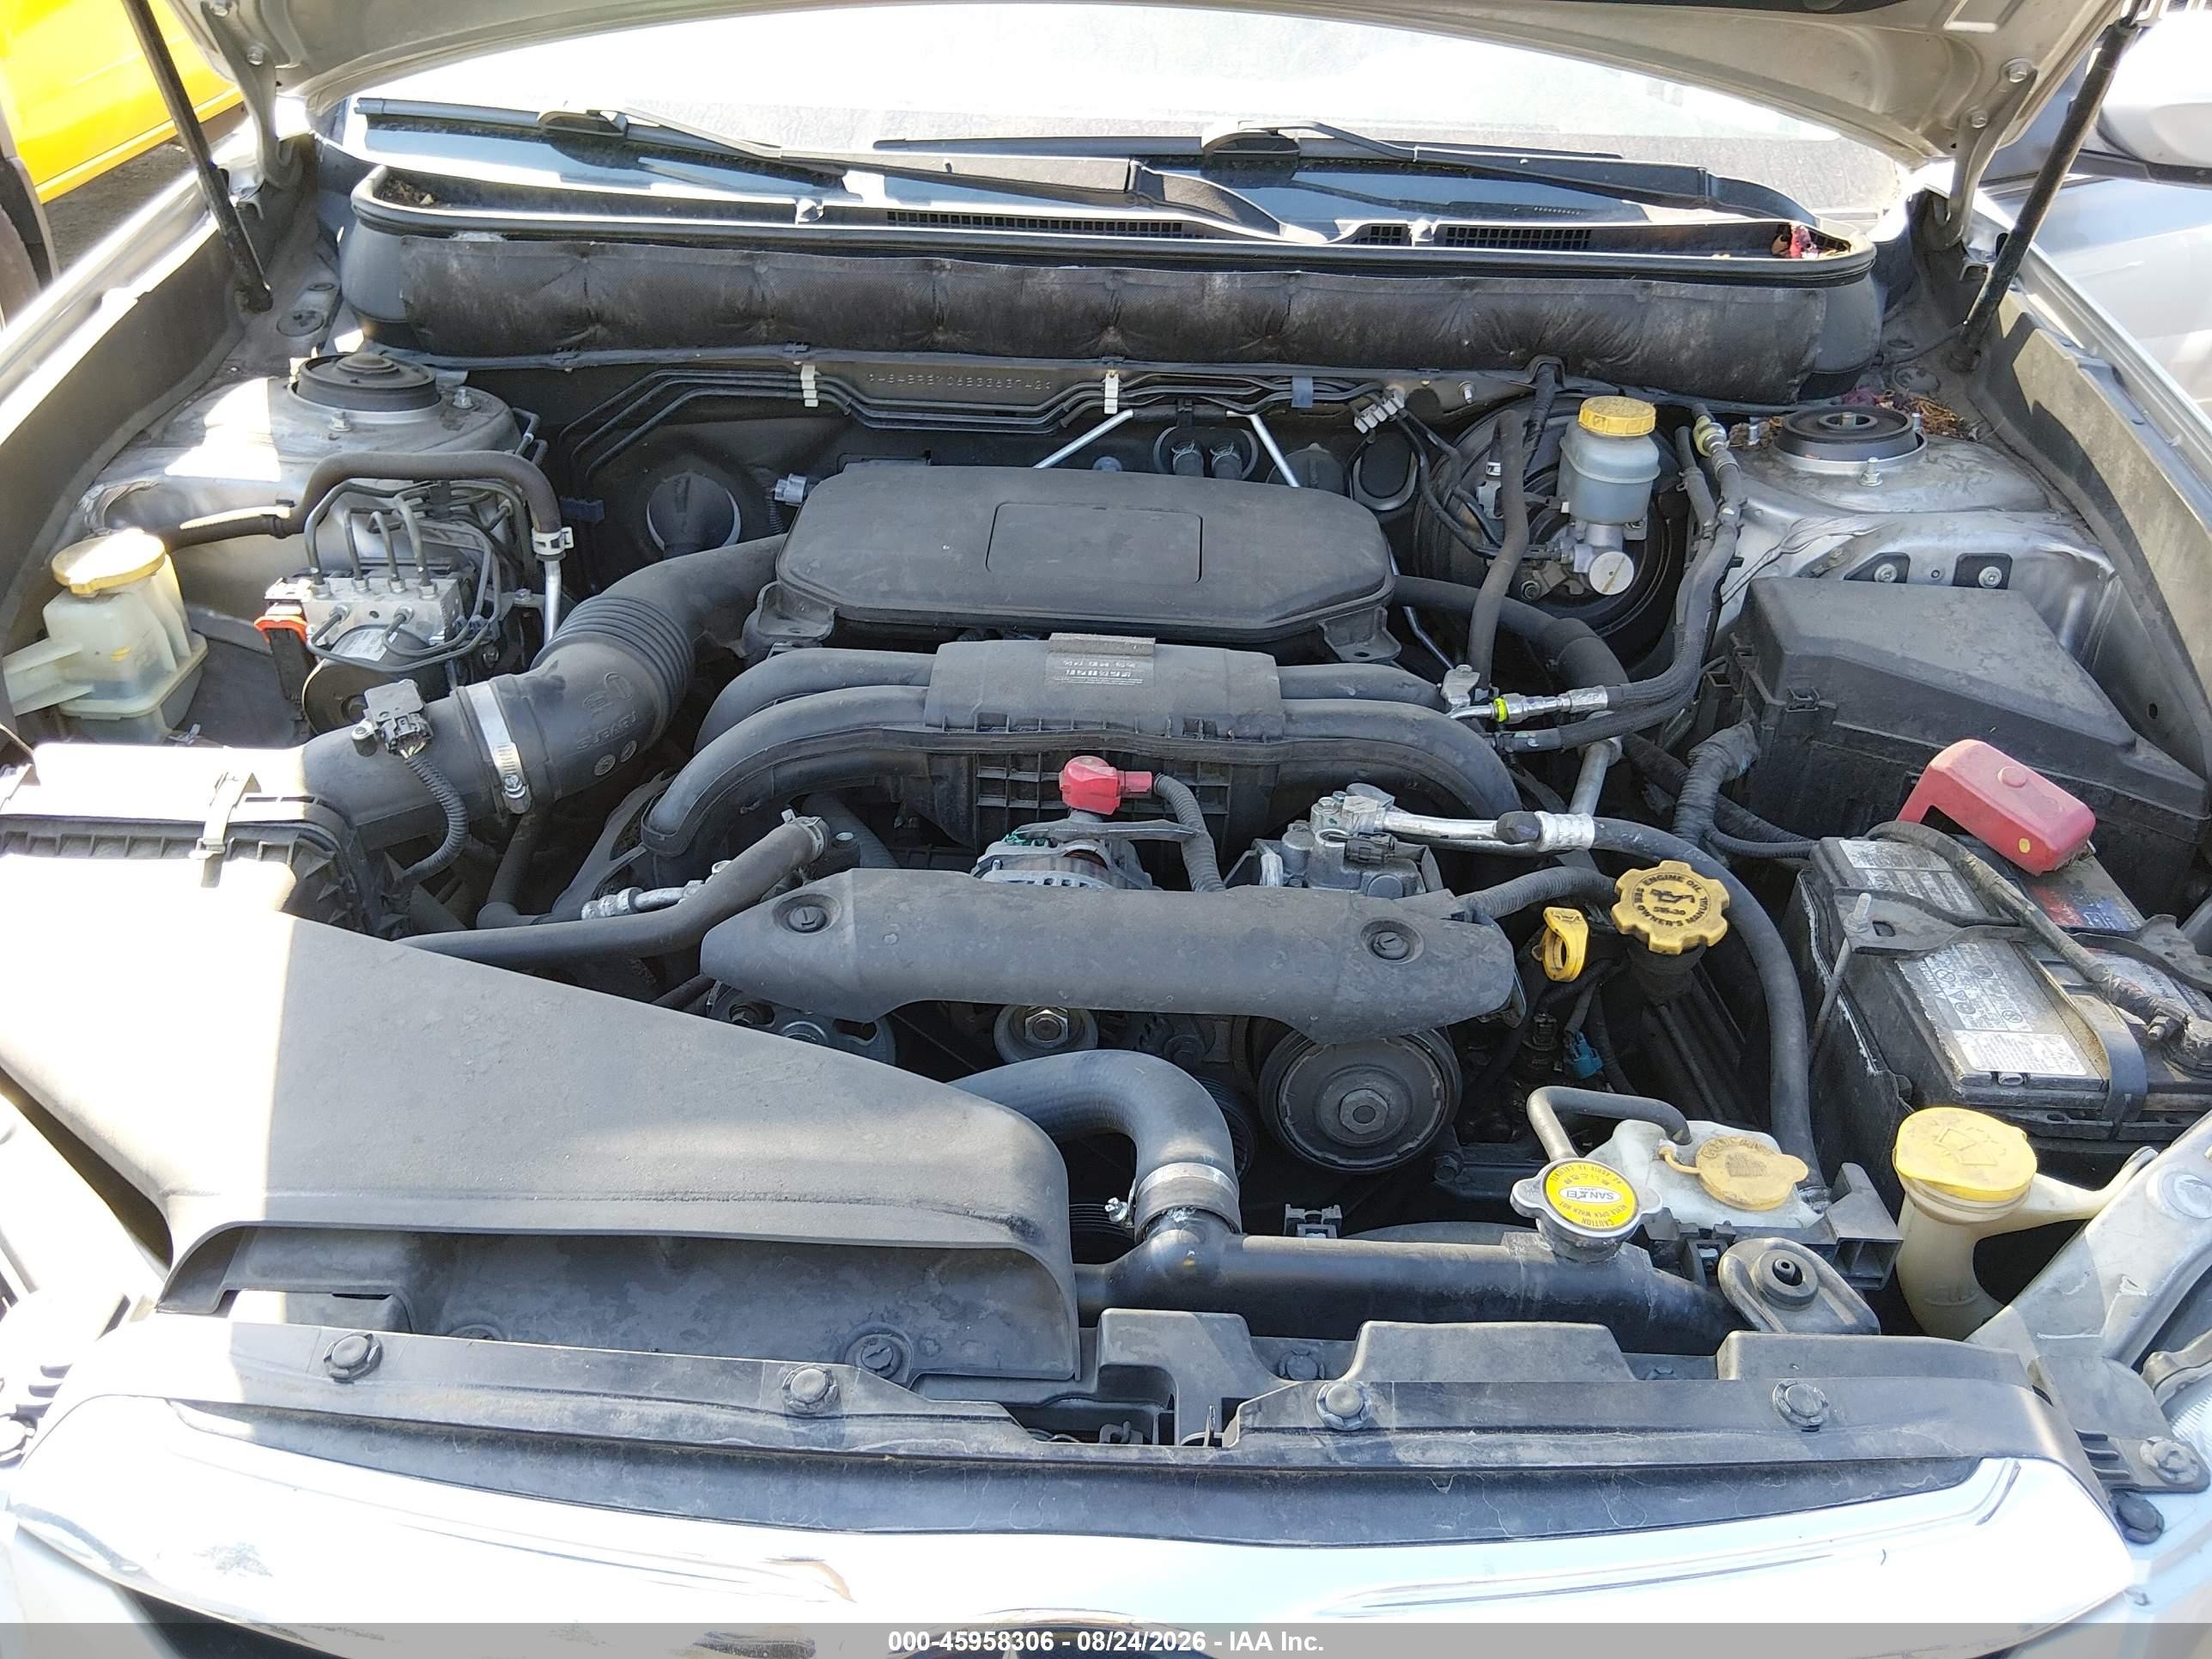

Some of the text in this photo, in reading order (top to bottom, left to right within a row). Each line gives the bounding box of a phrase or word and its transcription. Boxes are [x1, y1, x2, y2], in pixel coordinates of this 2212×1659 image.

[1643, 874, 1703, 893] ENGINE OIL
[1638, 905, 1684, 927] OWNER'S
[1686, 896, 1709, 924] MANUAL
[1653, 906, 1686, 915] 5W-30
[1581, 1217, 1615, 1227] CAUTION
